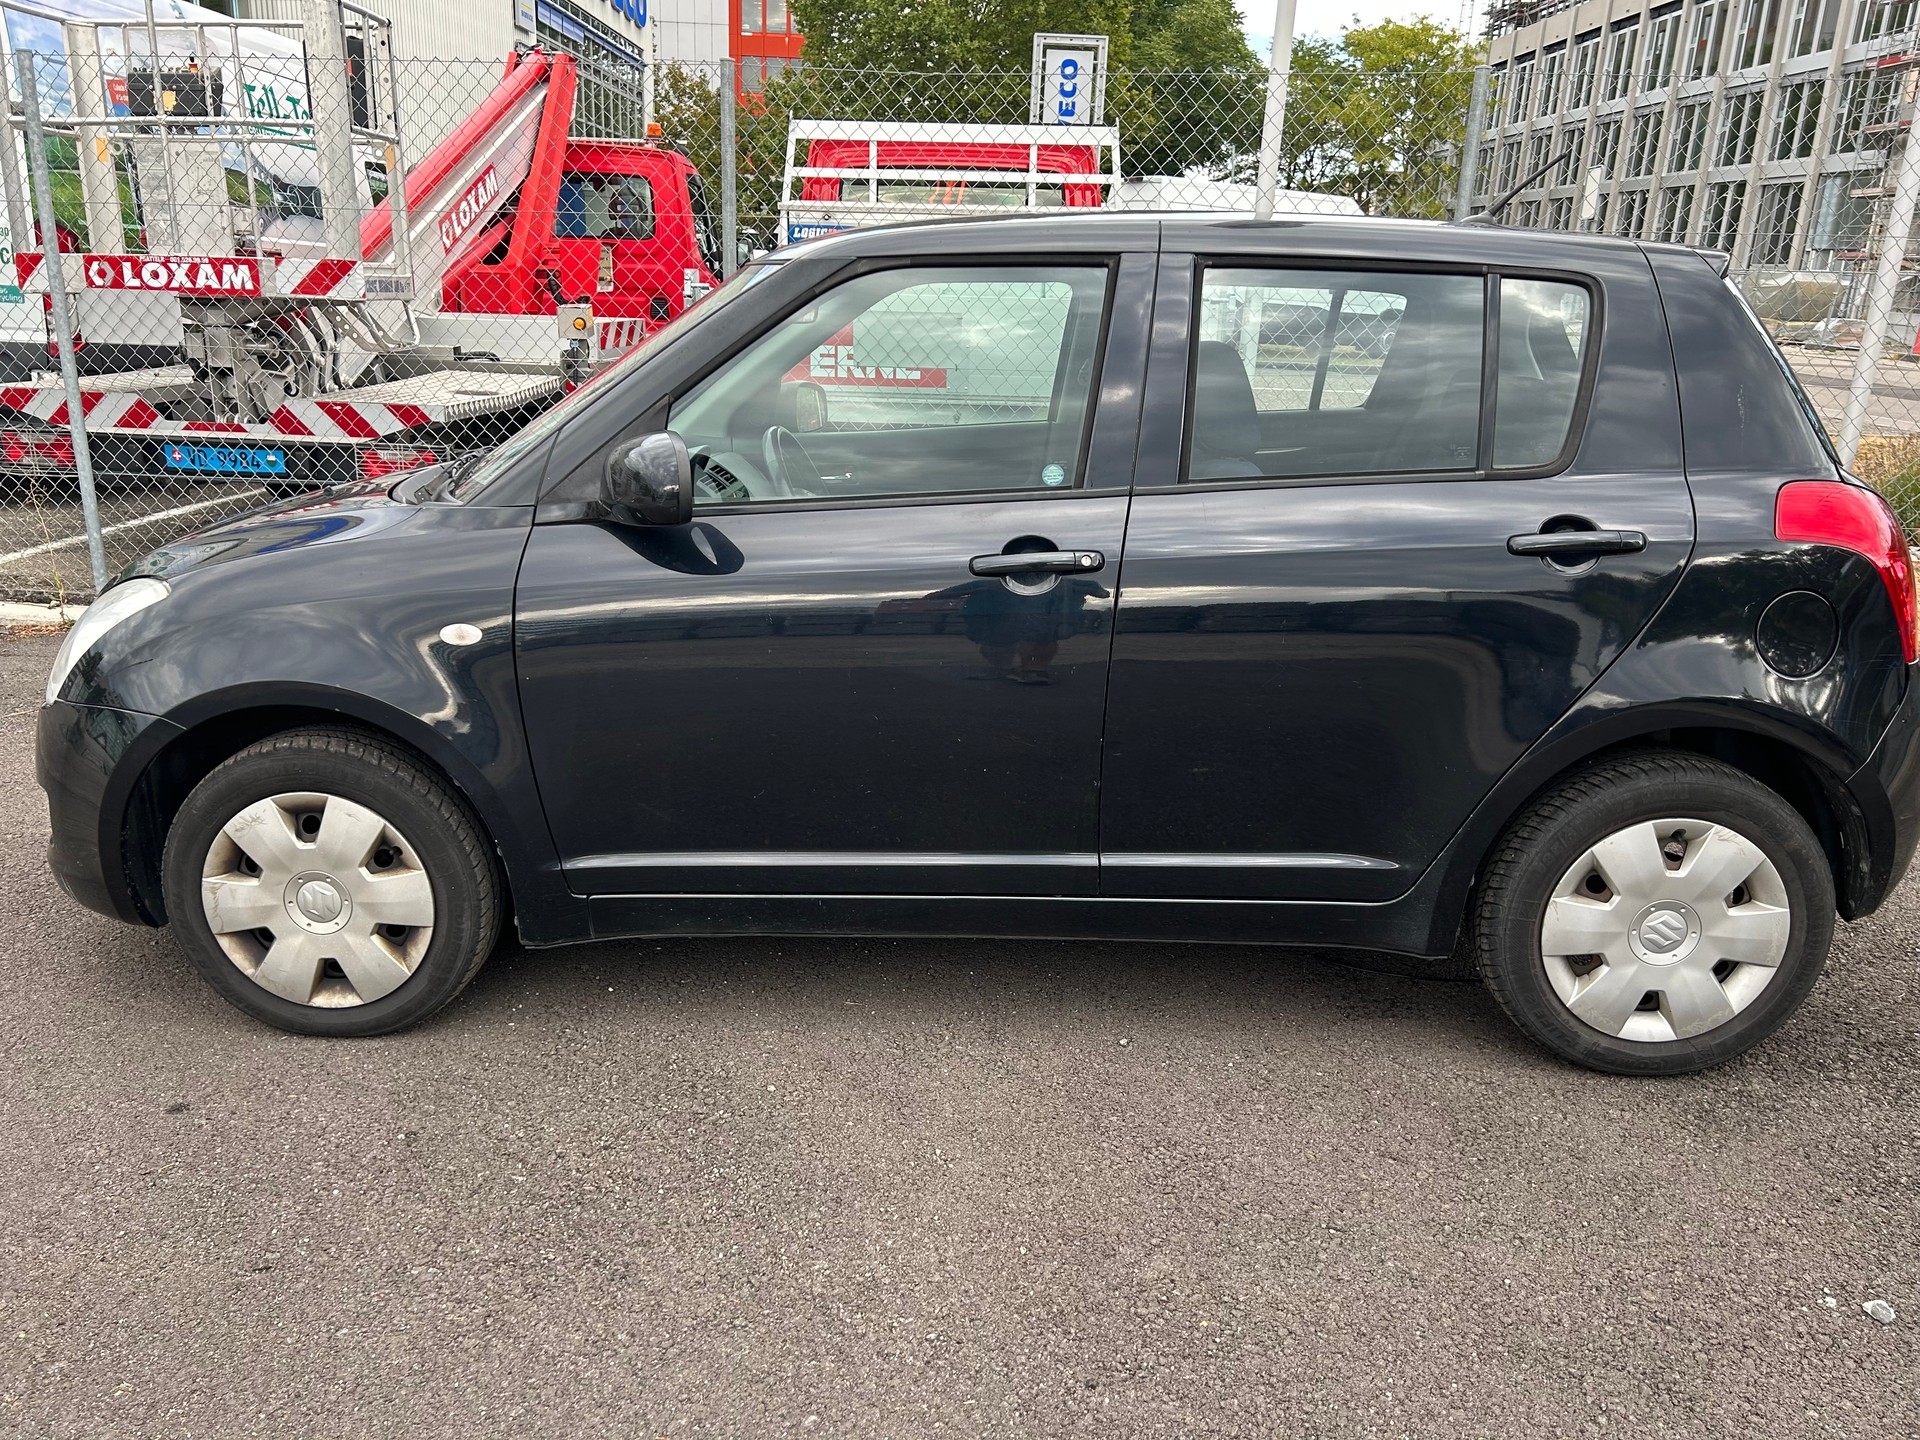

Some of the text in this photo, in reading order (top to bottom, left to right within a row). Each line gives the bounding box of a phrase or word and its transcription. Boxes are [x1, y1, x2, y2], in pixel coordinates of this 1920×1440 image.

[451, 168, 499, 238] LOXAM
[121, 261, 254, 290] LOXAM
[216, 450, 261, 469] 9984
